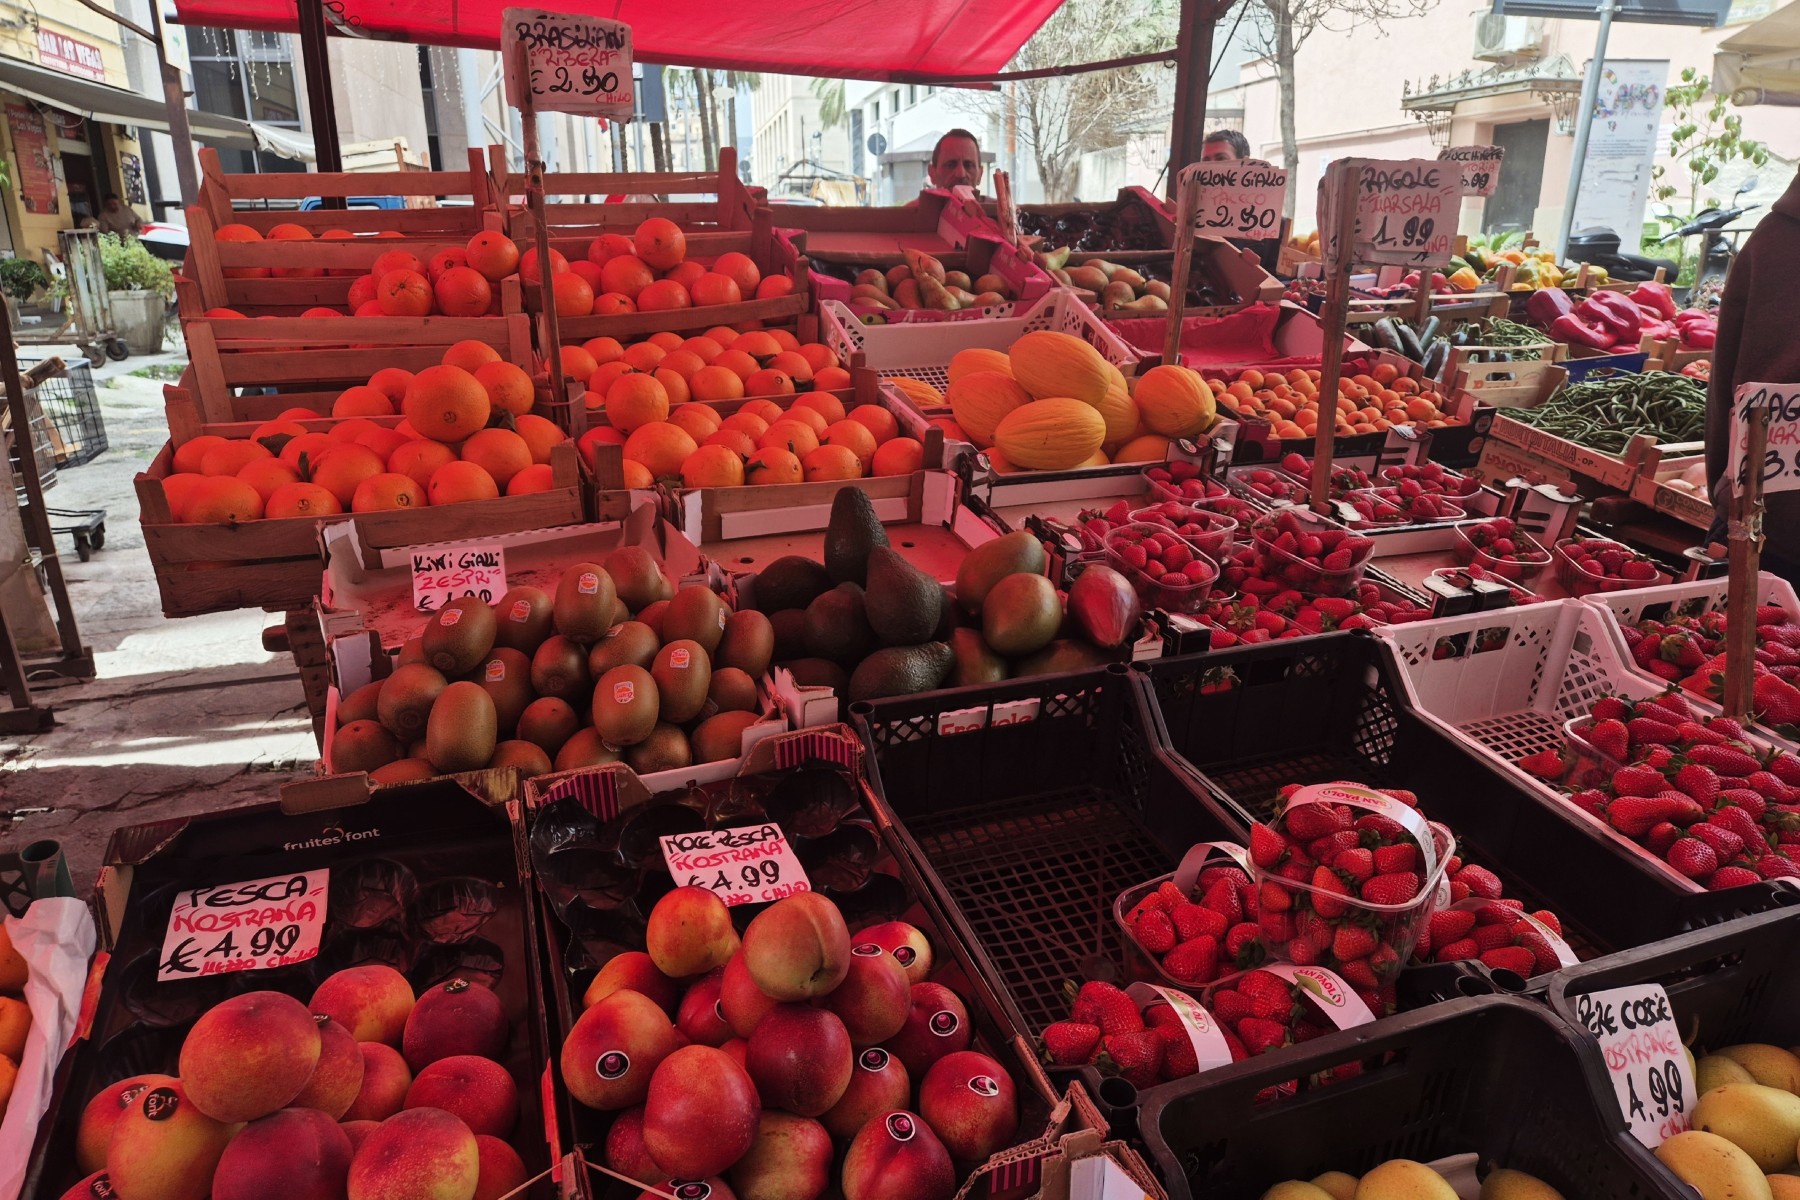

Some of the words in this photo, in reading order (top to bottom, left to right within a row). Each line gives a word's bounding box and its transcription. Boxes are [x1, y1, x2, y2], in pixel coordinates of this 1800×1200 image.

[283, 836, 341, 851] fruites
[345, 828, 381, 842] font
[190, 875, 308, 908] PESCA
